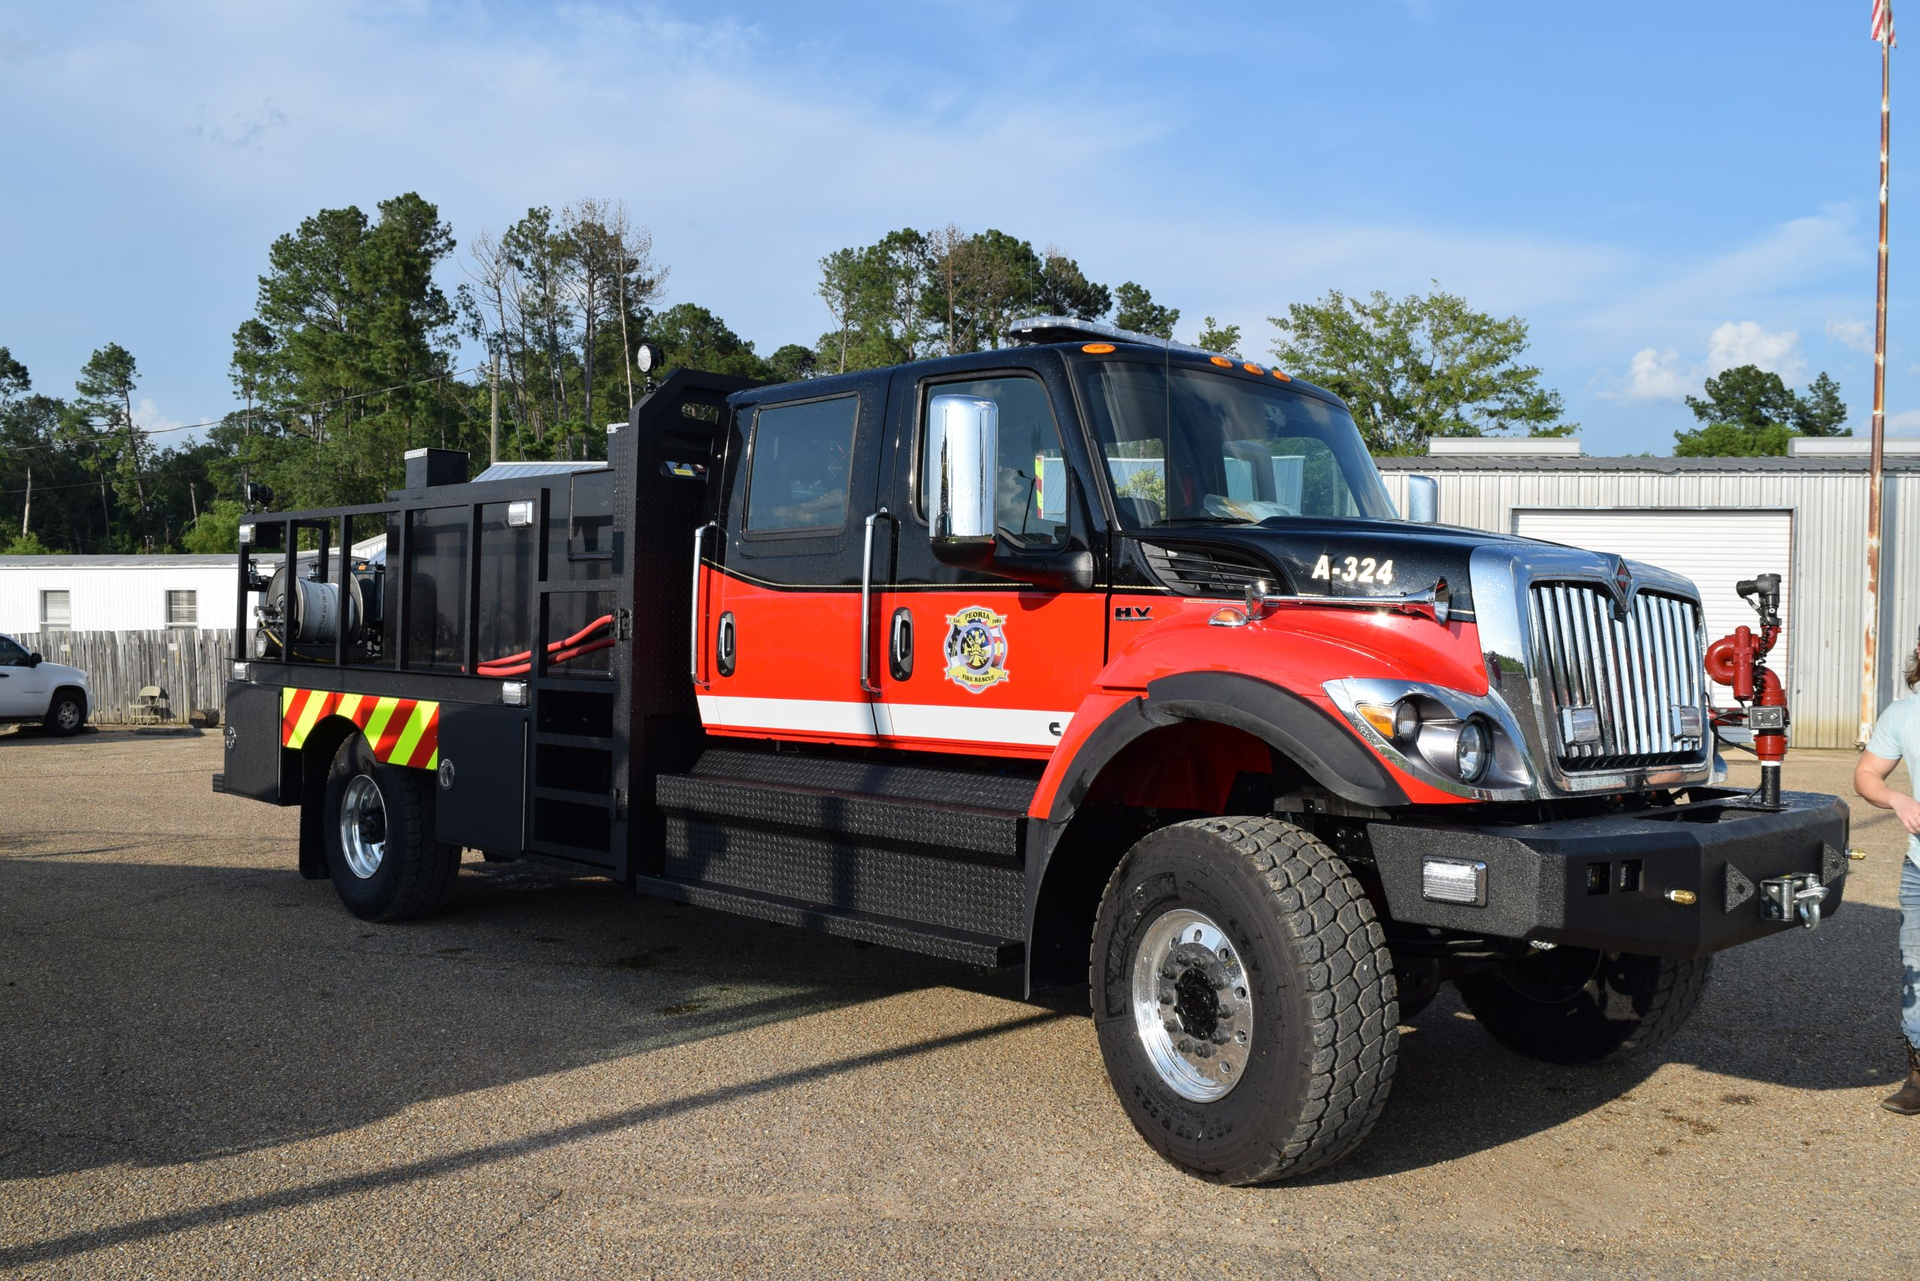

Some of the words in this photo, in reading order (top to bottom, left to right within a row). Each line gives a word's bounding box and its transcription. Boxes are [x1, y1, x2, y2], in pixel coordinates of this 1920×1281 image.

[1311, 554, 1393, 585] A-324
[965, 611, 991, 620] PEORIA
[1115, 606, 1152, 618] HV
[962, 673, 973, 682] FIRE
[974, 674, 995, 682] RESCUE
